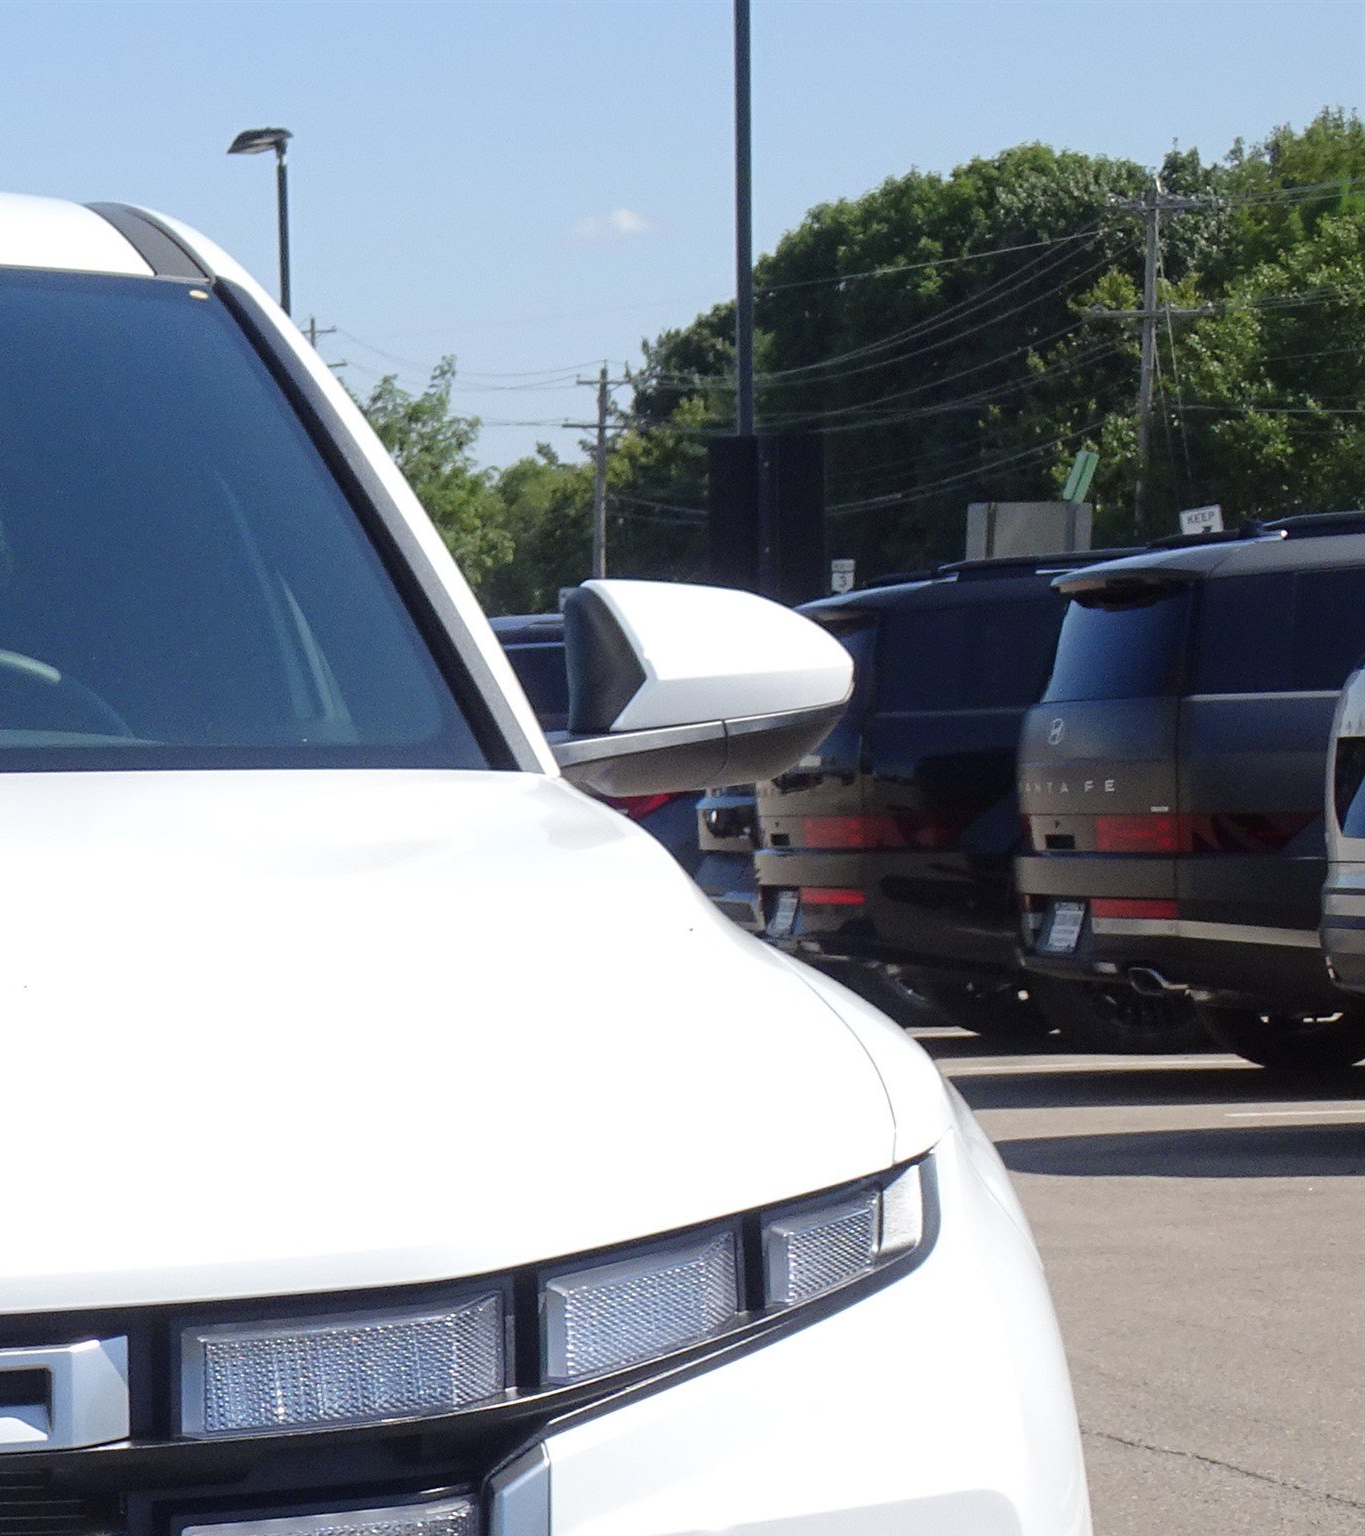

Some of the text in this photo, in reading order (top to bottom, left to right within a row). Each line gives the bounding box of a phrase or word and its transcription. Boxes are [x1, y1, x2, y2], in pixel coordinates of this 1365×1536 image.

[1186, 511, 1215, 525] KEEP
[1024, 779, 1116, 793] ANTA FE
